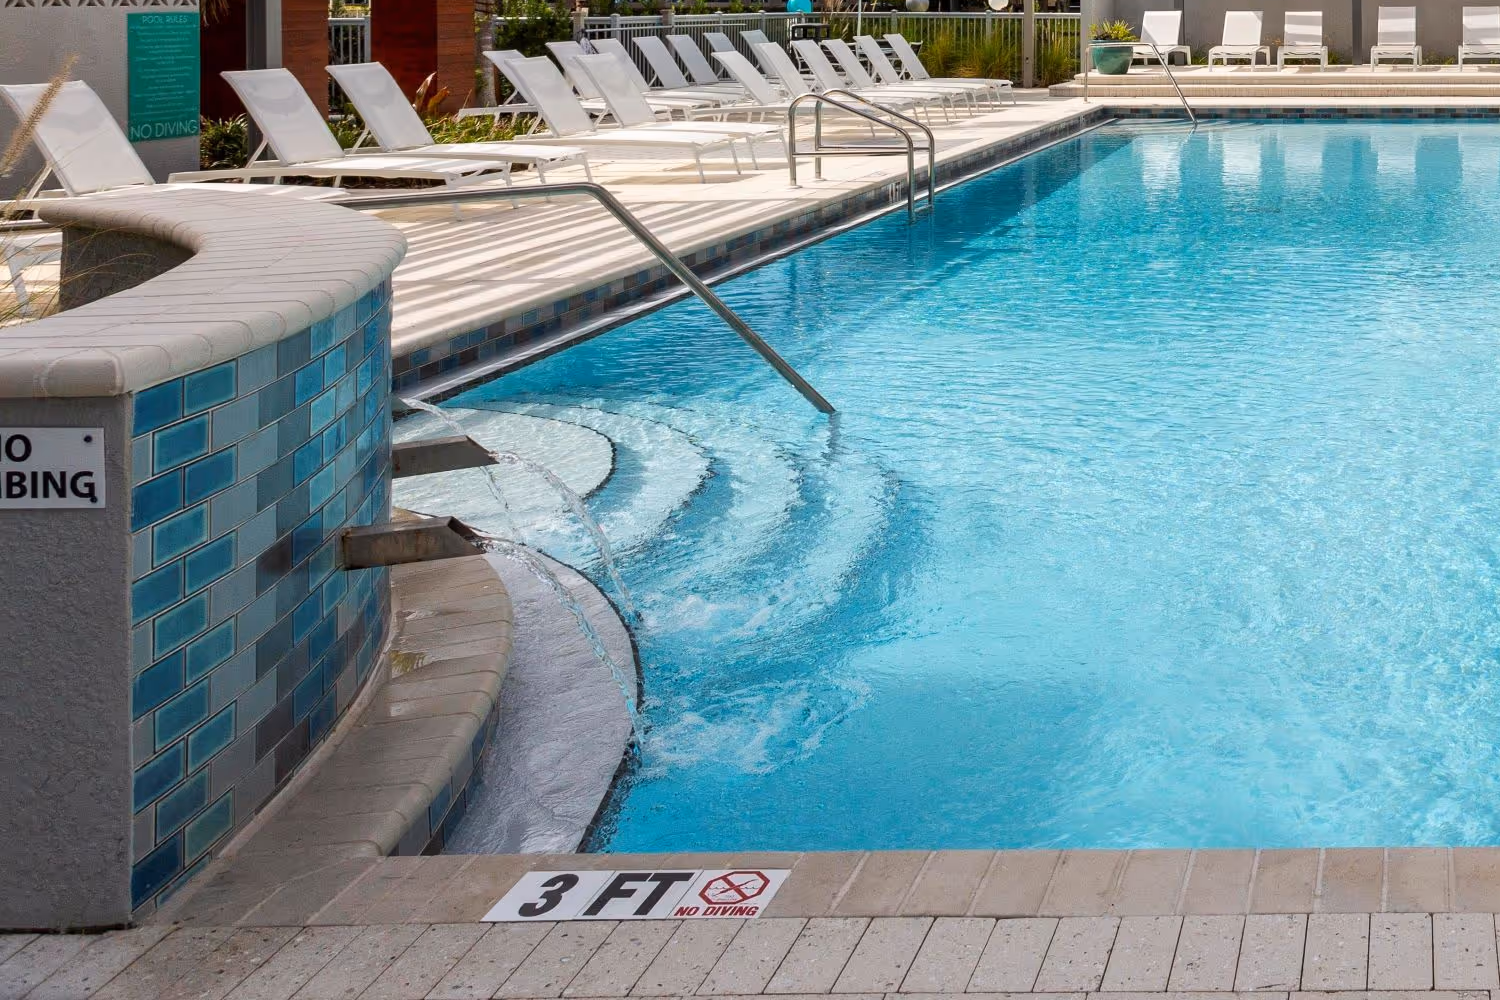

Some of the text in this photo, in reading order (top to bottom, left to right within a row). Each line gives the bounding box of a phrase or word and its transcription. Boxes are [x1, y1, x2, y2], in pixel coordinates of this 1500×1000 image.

[130, 119, 198, 139] NO DIVING
[0, 434, 32, 462] O
[0, 471, 95, 499] BING
[518, 872, 695, 917] 3 FT
[674, 906, 759, 916] NO DIVING
